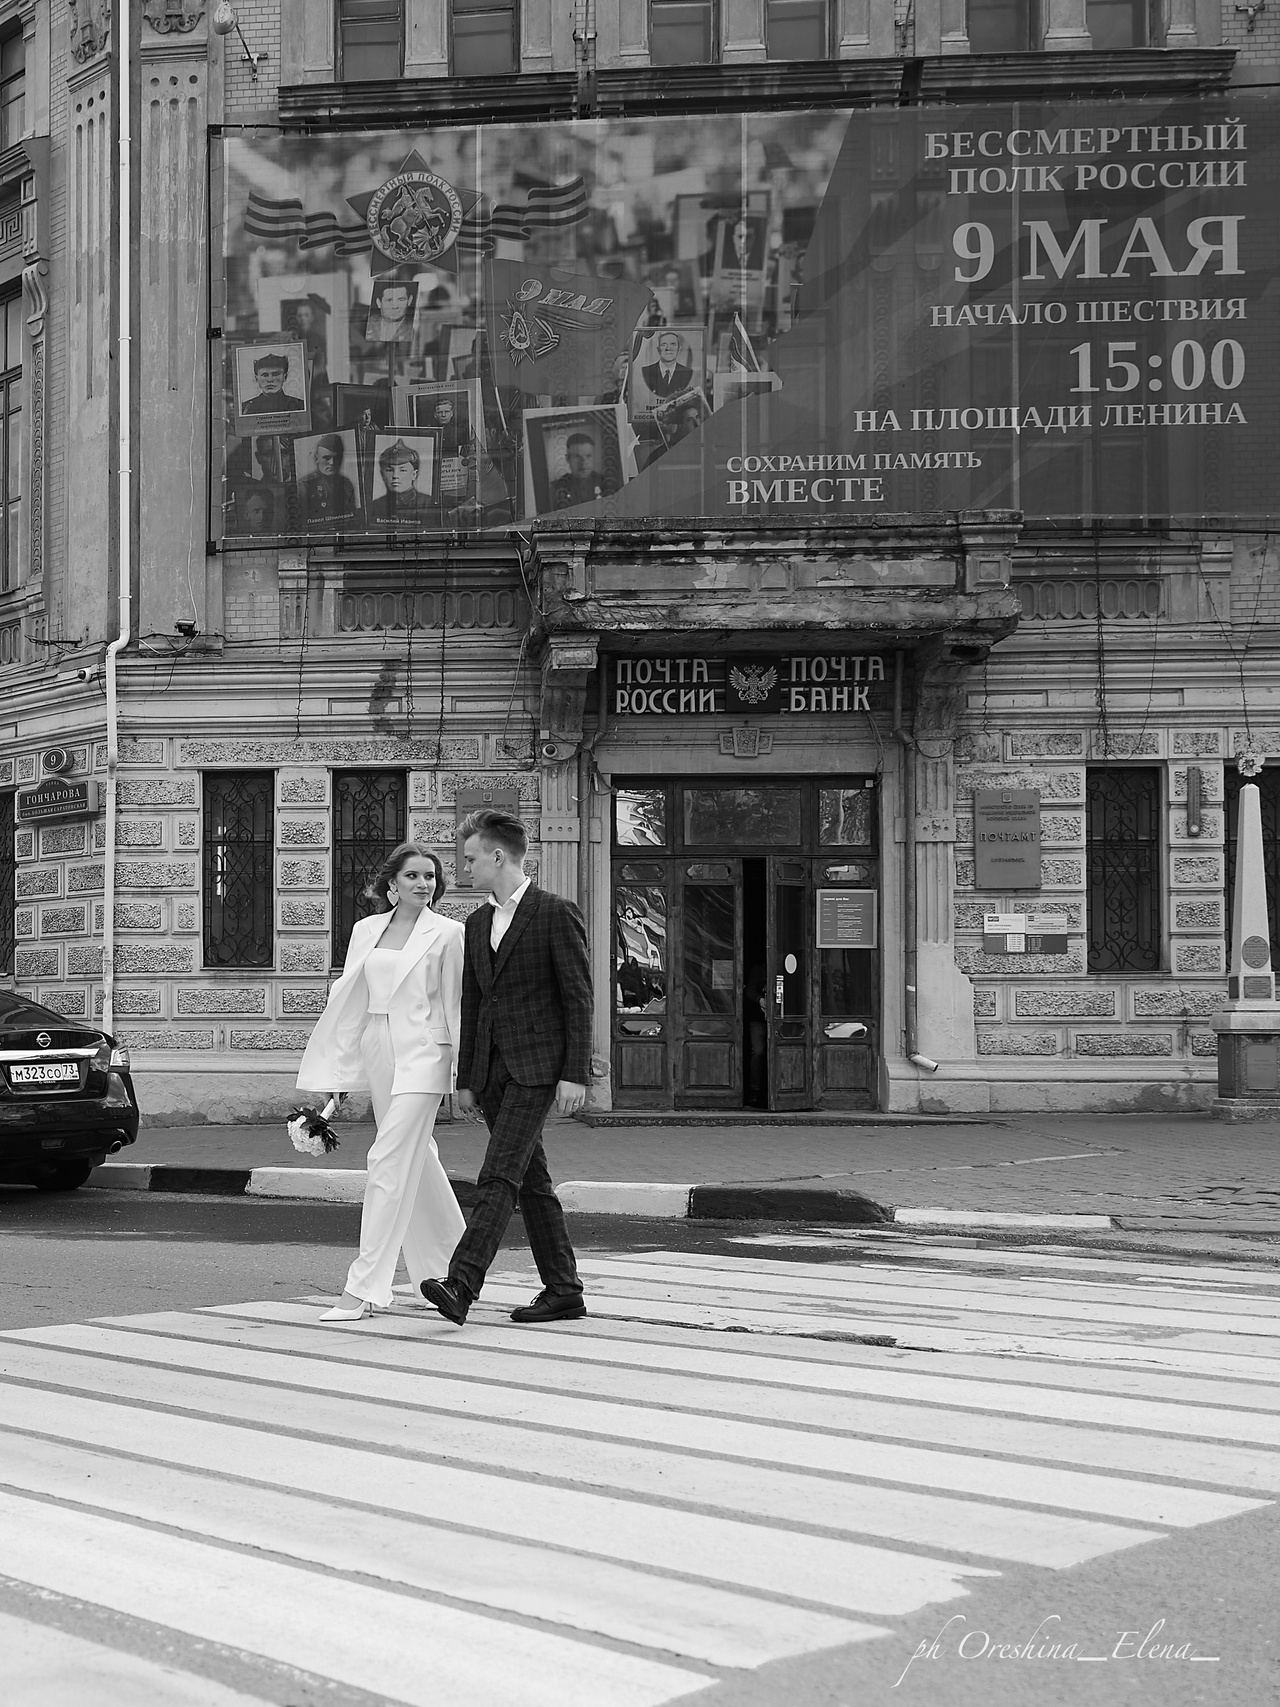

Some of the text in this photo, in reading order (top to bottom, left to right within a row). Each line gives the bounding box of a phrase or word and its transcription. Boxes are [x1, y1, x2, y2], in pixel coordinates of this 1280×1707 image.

[925, 117, 1247, 159] БЕССМЕРТНЫЙ
[948, 160, 1247, 195] ПОЛК РОССИИ
[368, 173, 462, 236] БЕССМЕРТНЫЙ ПОЛК РОССИИ
[951, 215, 1247, 283] 9 МАЯ
[515, 278, 614, 316] 9 МАЯ
[930, 297, 1247, 327] НАЧАЛО ШЕСТВИЯ
[1069, 338, 1246, 393] 15:00
[854, 402, 1247, 436] НА ПЛОЩАДИ ЛЕНИНА
[726, 451, 982, 473] СОХРАНИМ ПАМЯТЬ
[726, 477, 885, 505] ВМЕСТЕ
[616, 658, 710, 684] ПОЧТА
[790, 656, 886, 682] ПОЧТА
[616, 687, 716, 714] РОССИИ
[790, 684, 872, 713] БАНК
[50, 754, 57, 766] 9
[26, 788, 80, 805] ГОНЧАРОВА
[980, 832, 1037, 842] ПОЧТАМТ
